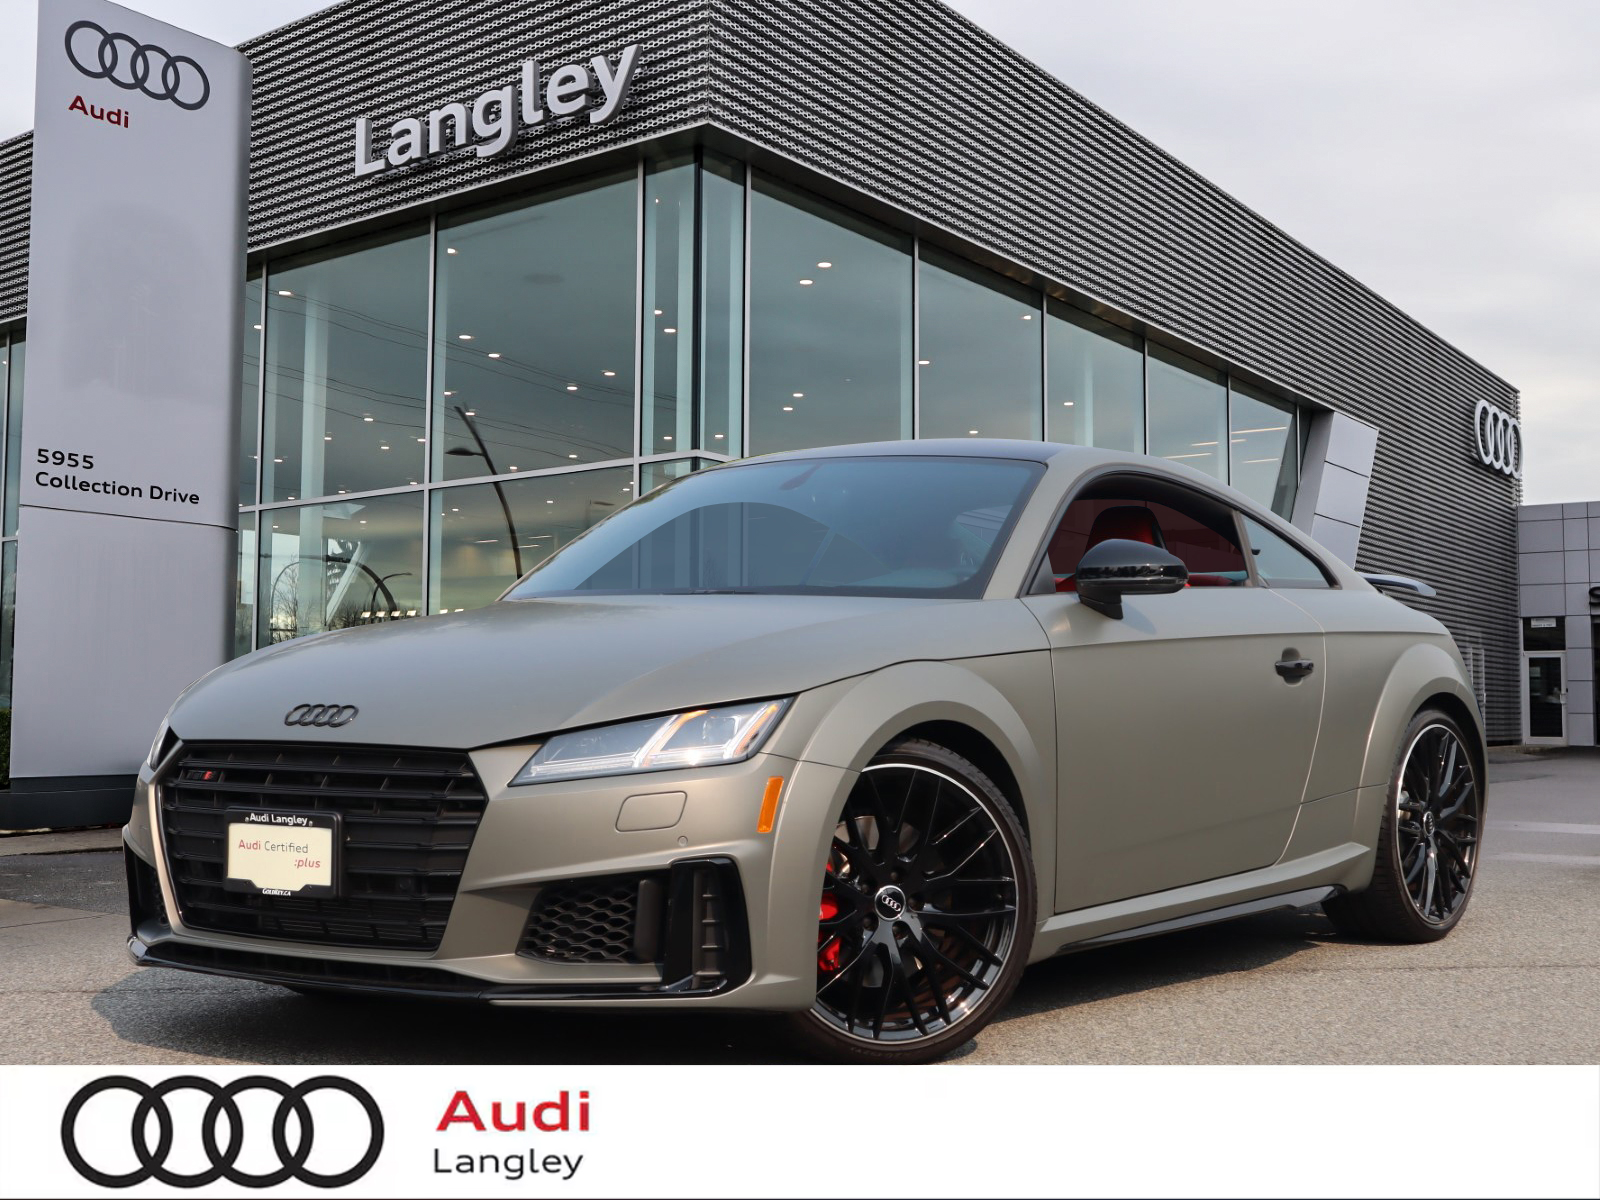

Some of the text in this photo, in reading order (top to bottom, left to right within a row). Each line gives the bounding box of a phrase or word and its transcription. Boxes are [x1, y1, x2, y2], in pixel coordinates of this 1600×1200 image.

[69, 95, 129, 129] Audi
[354, 44, 643, 177] Langley
[37, 448, 94, 470] 5955
[35, 471, 200, 505] Collection Drive
[249, 812, 308, 827] Audi Langley
[238, 839, 309, 854] Audi Certified
[294, 857, 321, 869] :plus
